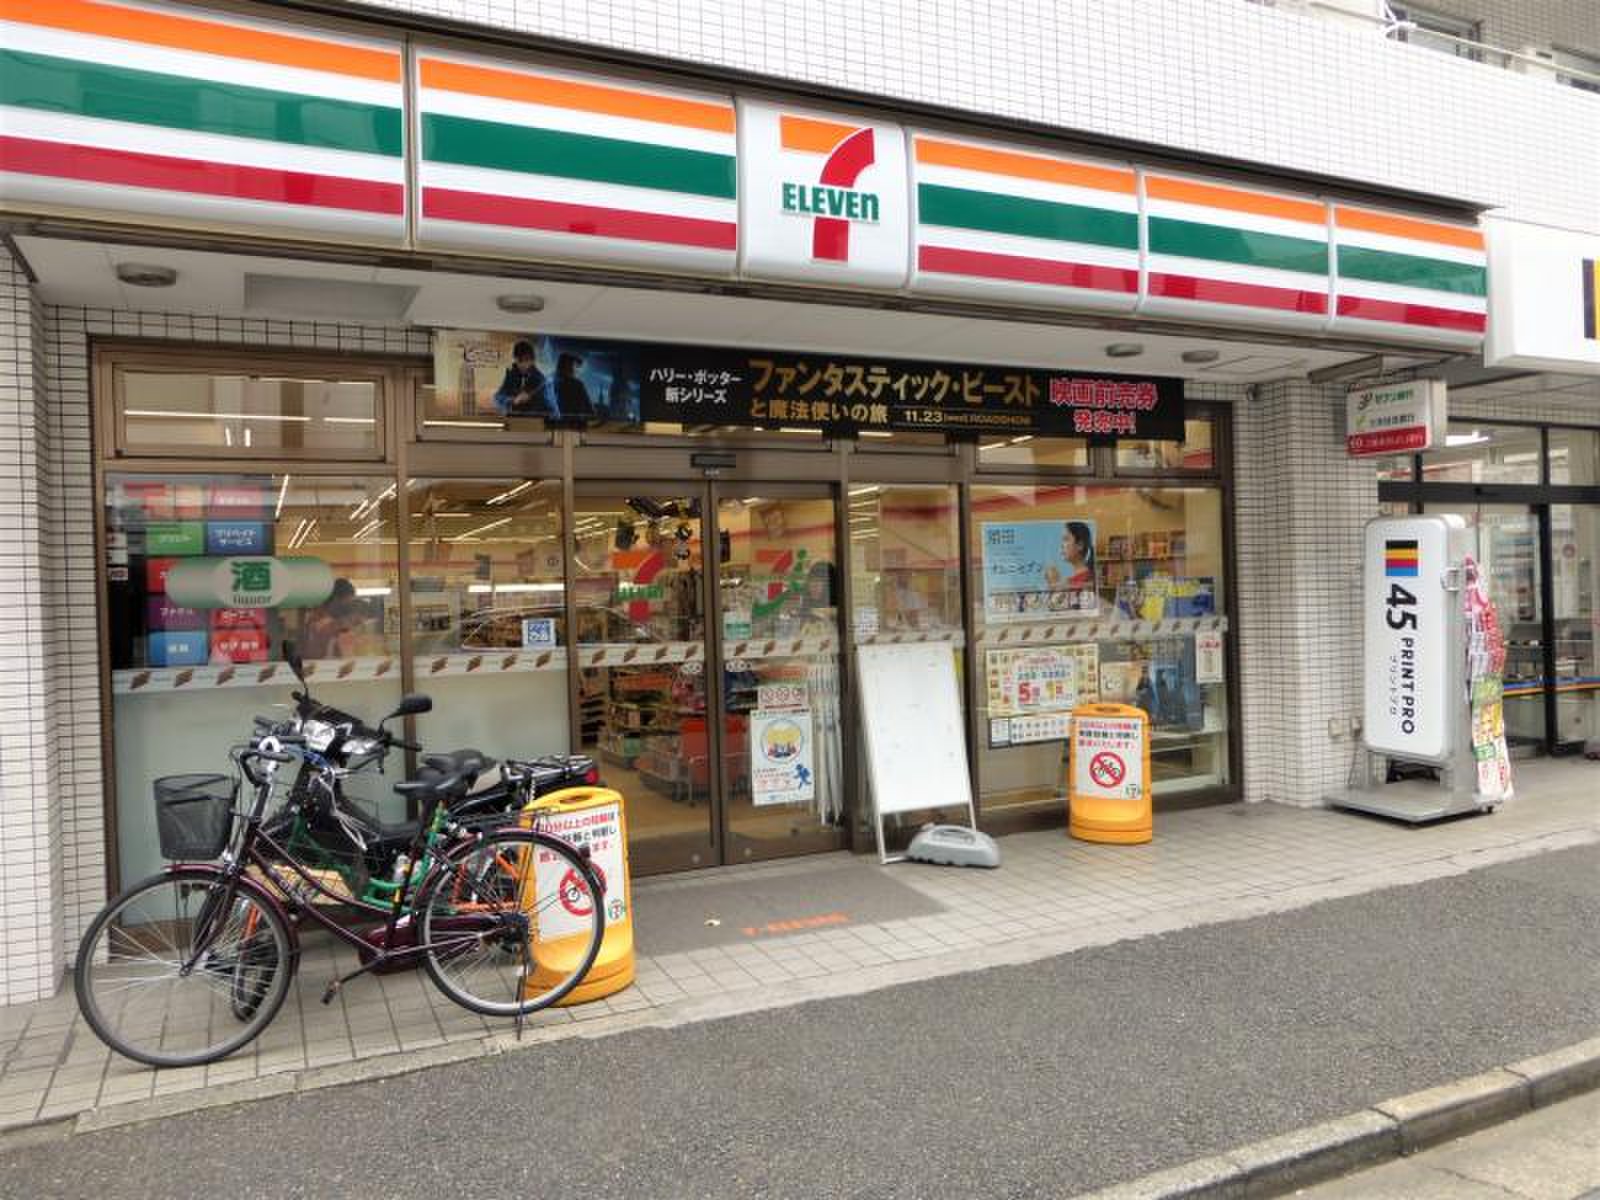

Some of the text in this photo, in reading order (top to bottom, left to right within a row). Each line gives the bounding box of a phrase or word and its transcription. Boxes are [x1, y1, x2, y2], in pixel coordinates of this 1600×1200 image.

[649, 367, 742, 385] ハリー・ポッター
[749, 358, 1040, 405] ファンタスティック・ビースト
[665, 387, 728, 404] 新シリーズ
[1050, 379, 1158, 409] 映画前売券
[751, 400, 889, 424] と魔法使いの旅
[905, 410, 943, 422] 11.23
[231, 560, 272, 592] 酒
[1386, 583, 1418, 631] 45
[1400, 637, 1416, 735] PRINT PRO
